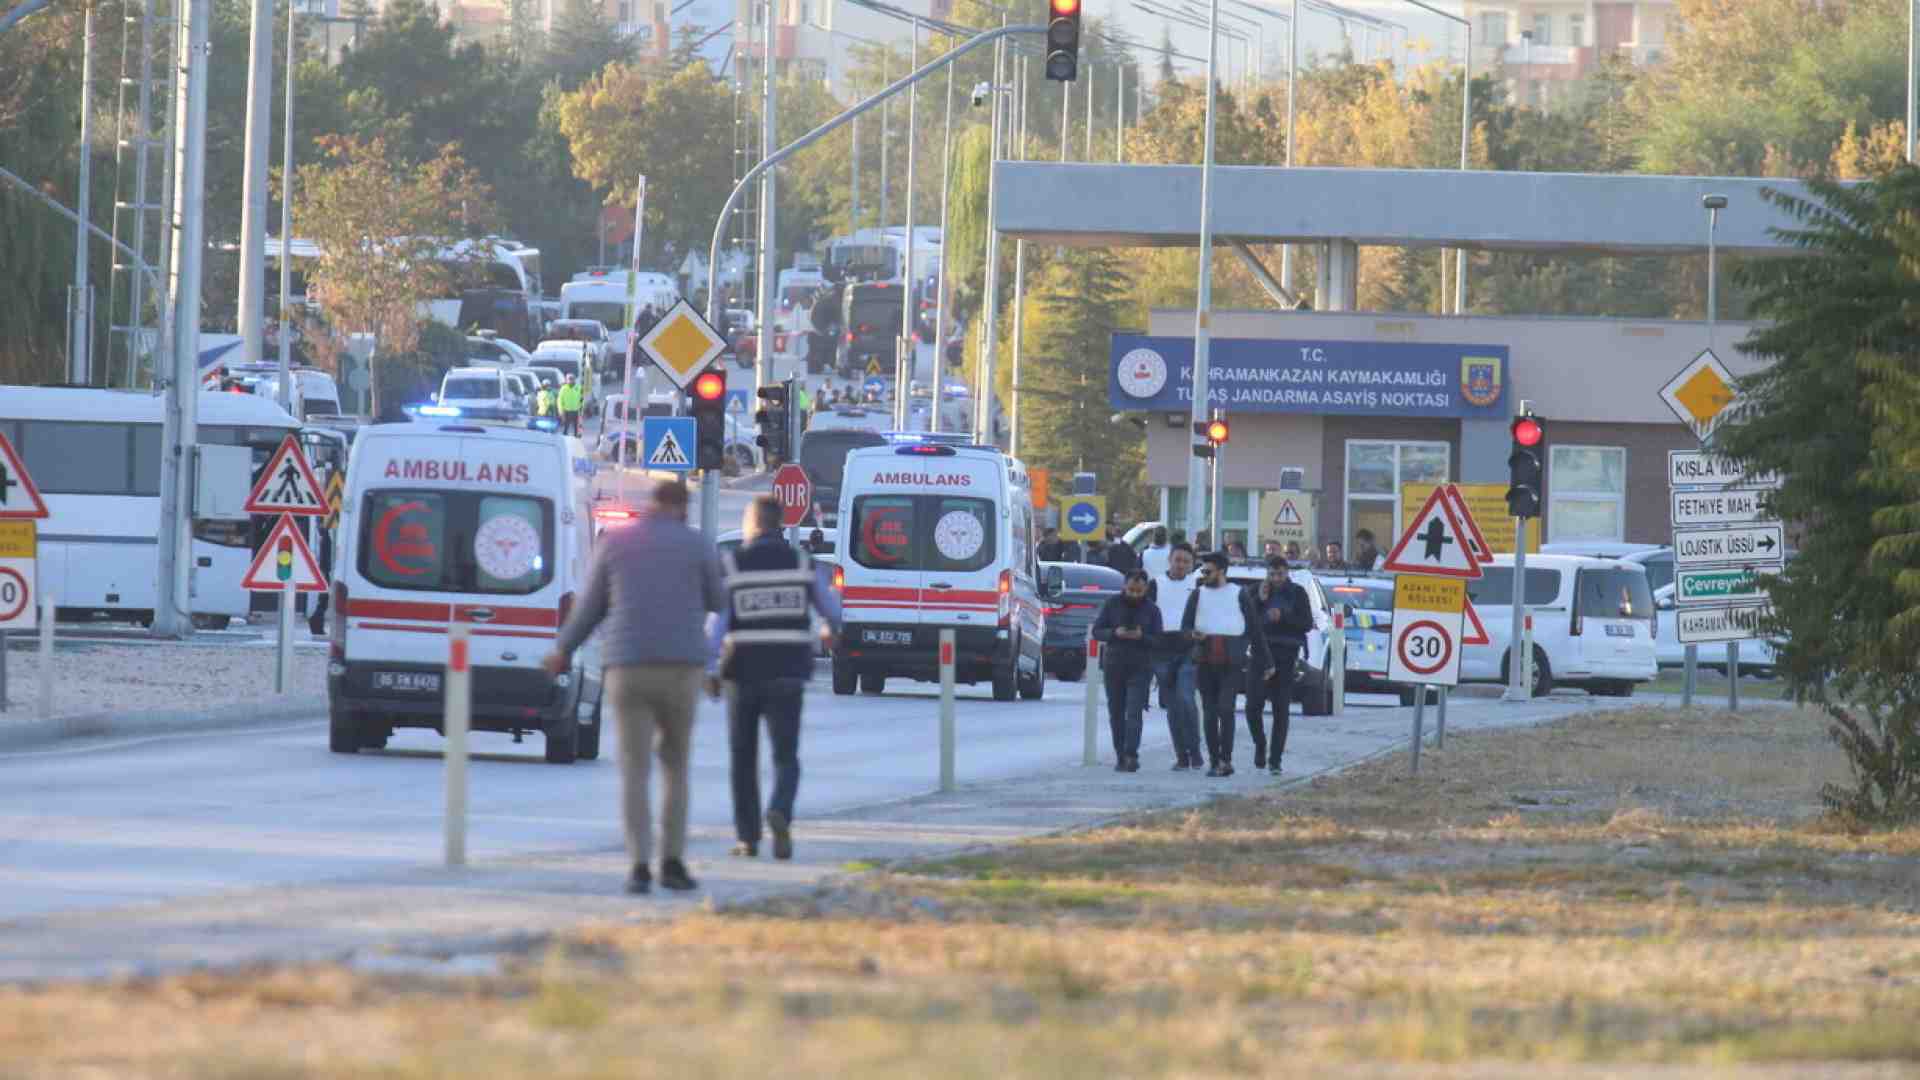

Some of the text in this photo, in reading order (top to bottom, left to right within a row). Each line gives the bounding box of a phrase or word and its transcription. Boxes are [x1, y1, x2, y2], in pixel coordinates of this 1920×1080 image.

[1301, 348, 1327, 363] T.C.
[1180, 366, 1446, 386] KHRAMANKAZAN KAYMAKAMLIĞI
[1176, 387, 1448, 407] TUAŞ JANDARMA ASAYİŞ NOKTASI
[384, 458, 529, 484] AMBULANS
[873, 471, 972, 487] AMBULANS
[774, 483, 806, 507] DUR
[1684, 574, 1755, 595] Çevreyo
[1410, 635, 1440, 658] 30
